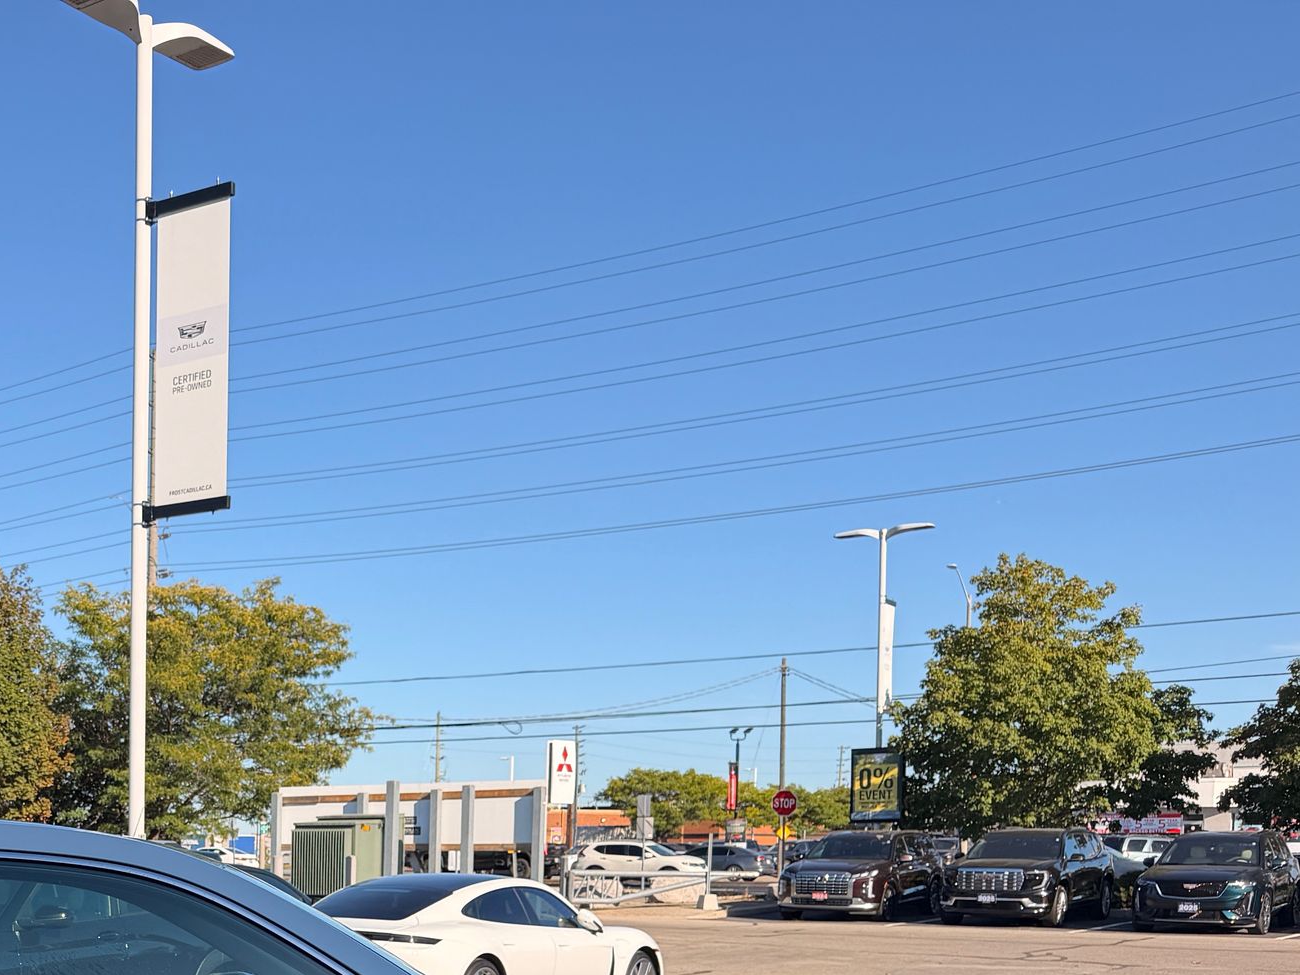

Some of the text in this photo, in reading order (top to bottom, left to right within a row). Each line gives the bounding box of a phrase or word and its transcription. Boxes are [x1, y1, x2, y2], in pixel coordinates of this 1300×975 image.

[169, 338, 214, 353] CADILLAC
[172, 369, 212, 386] CERTIFIED
[172, 379, 212, 395] PRE-OWNED
[859, 766, 894, 790] 0%
[859, 790, 892, 801] EVENT
[773, 798, 796, 809] STOP
[1158, 819, 1166, 829] 5
